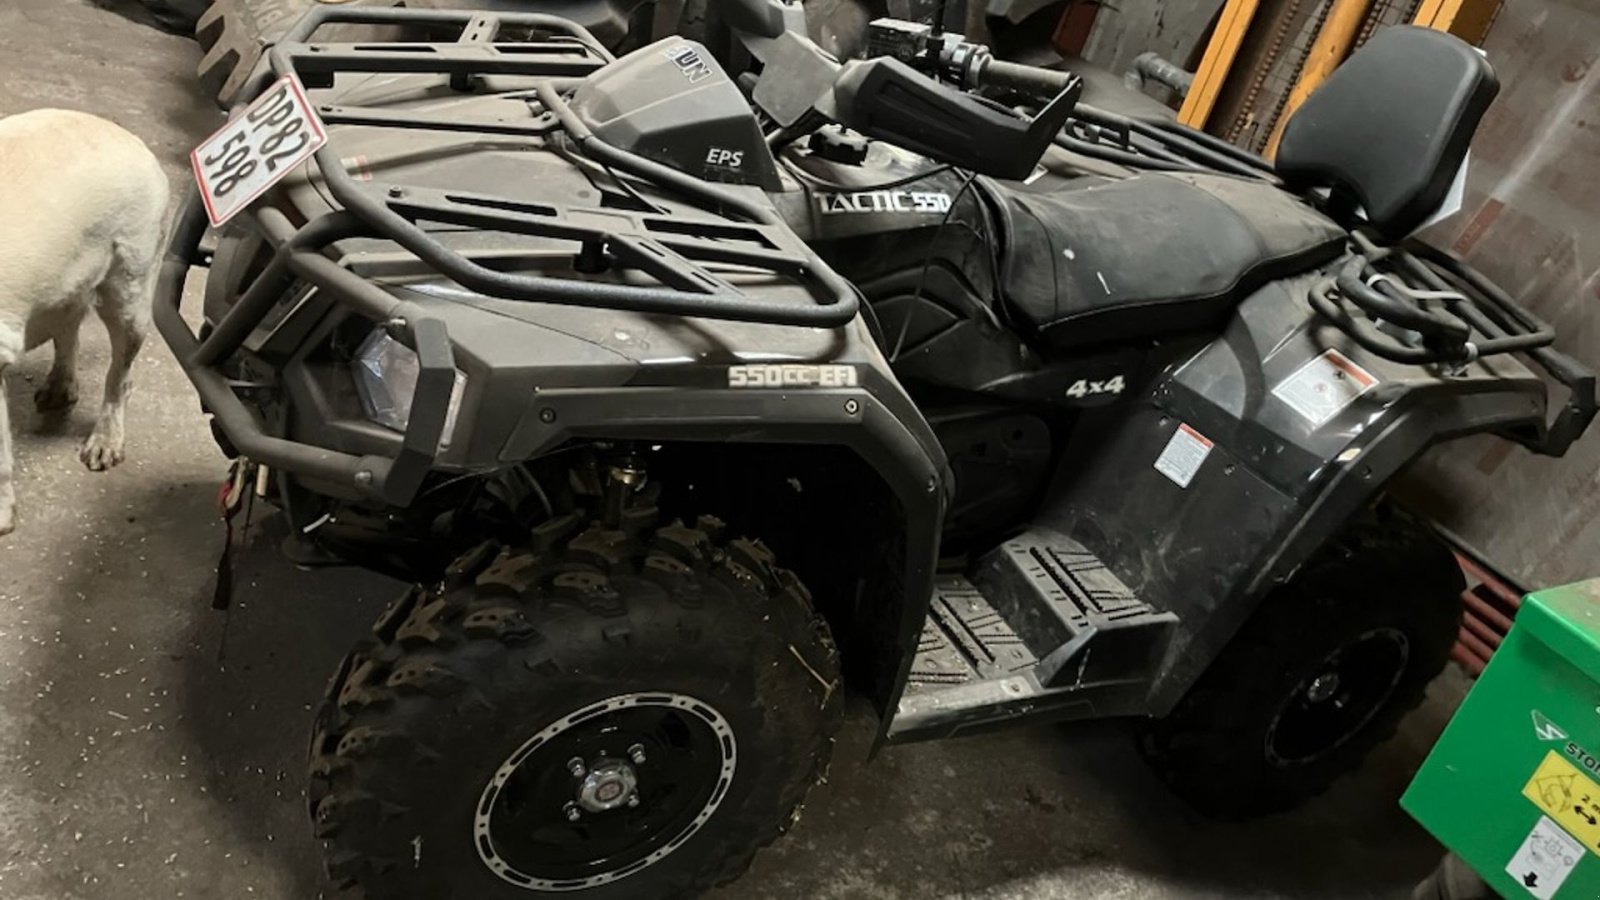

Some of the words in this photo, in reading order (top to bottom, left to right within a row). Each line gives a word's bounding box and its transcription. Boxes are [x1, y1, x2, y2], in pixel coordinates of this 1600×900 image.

[247, 87, 310, 172] DP82
[205, 131, 257, 197] 598
[706, 148, 743, 167] EPS
[813, 190, 911, 214] TACTIC
[911, 191, 952, 213] 550
[1066, 375, 1126, 398] 4x4
